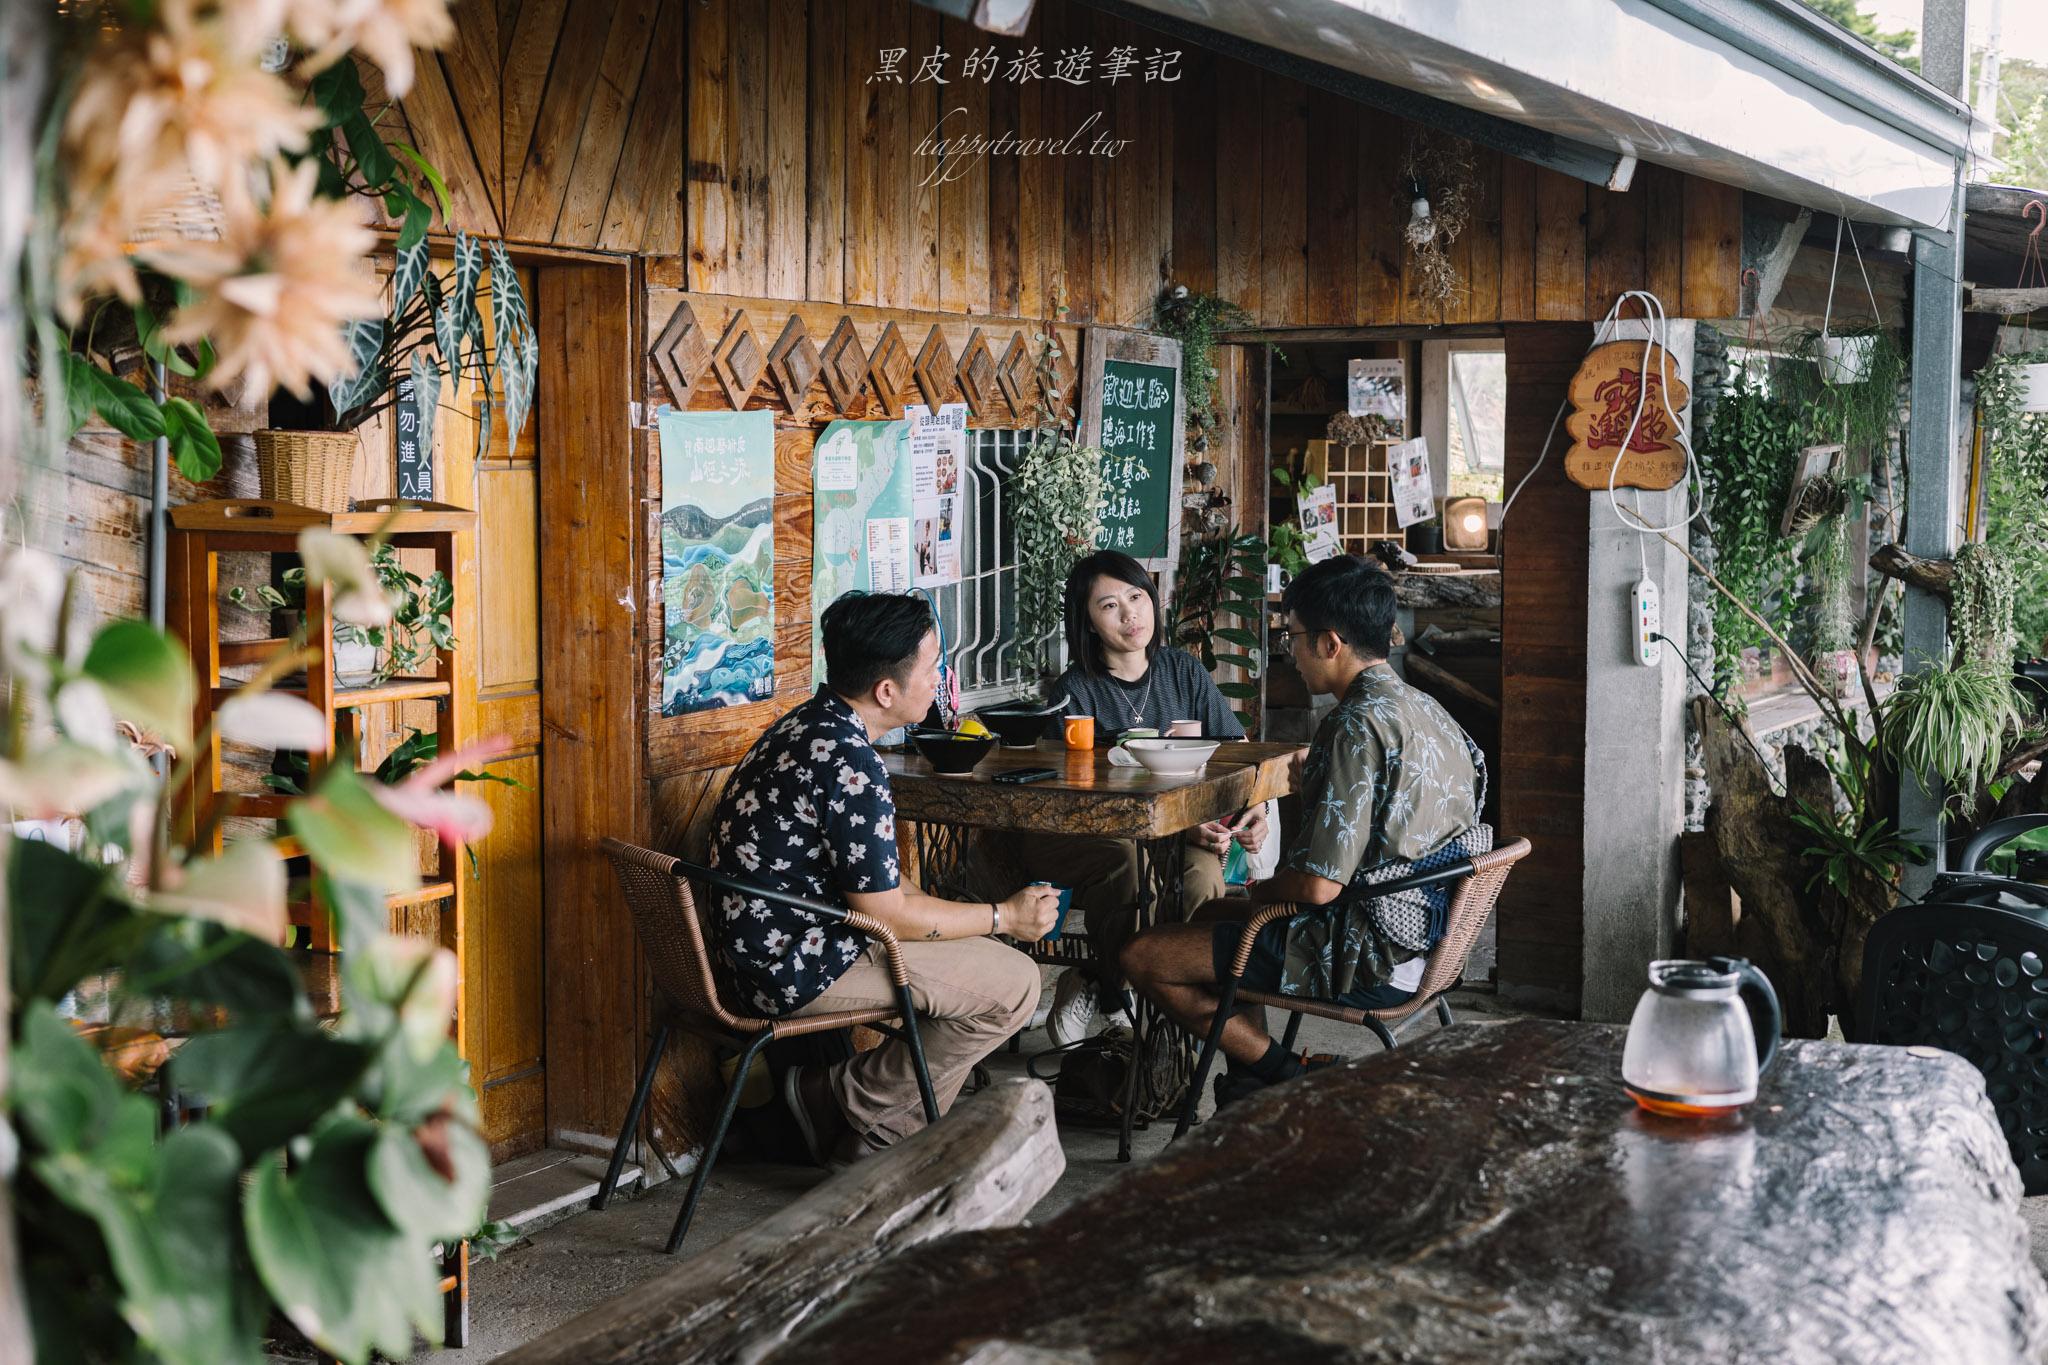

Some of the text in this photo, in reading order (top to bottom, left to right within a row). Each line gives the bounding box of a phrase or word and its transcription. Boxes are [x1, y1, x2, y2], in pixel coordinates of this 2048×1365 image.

[1102, 372, 1163, 410] 歡迎光臨
[400, 380, 416, 494] 請勿進入
[1114, 526, 1135, 548] 教學
